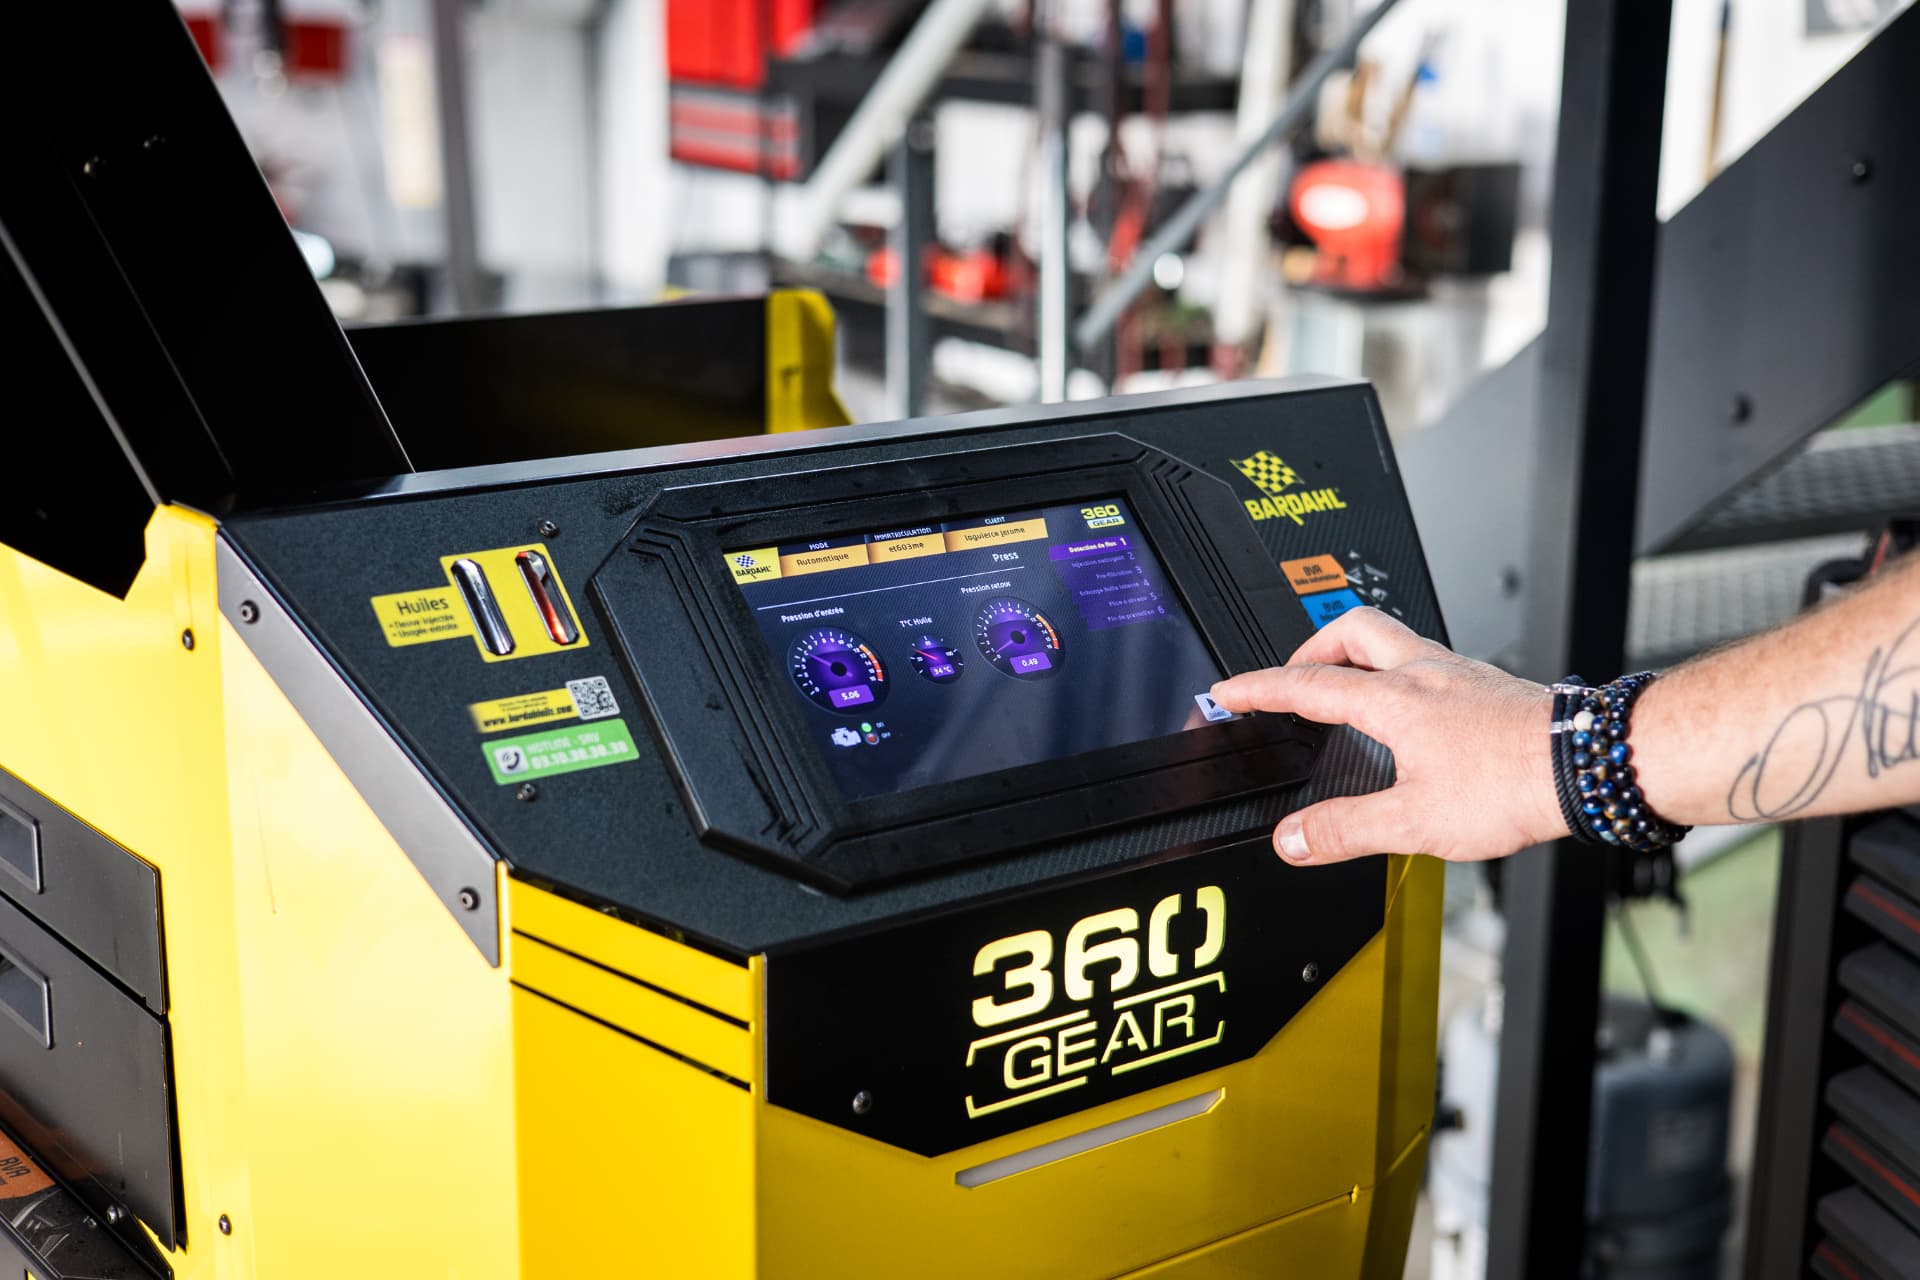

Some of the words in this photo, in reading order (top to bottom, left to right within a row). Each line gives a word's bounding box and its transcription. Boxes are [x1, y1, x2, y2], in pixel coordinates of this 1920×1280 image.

[1244, 488, 1347, 525] BARDAHL
[1081, 505, 1120, 520] 360
[1093, 518, 1119, 527] GEAR
[809, 541, 829, 551] MODE
[1120, 537, 1127, 546] 1
[888, 542, 925, 553] et603me
[796, 552, 849, 567] Automatique
[992, 551, 1019, 562] Press
[1128, 551, 1135, 560] 2
[735, 566, 771, 580] BARDAHL
[1135, 566, 1142, 574] 3
[1143, 579, 1150, 587] 4
[960, 584, 991, 594] Pression
[1150, 592, 1157, 601] 5
[397, 598, 449, 615] Huiles
[1157, 605, 1165, 614] 6
[781, 612, 814, 623] Pression
[972, 885, 1227, 1027] 360
[1003, 994, 1196, 1089] GEAR
